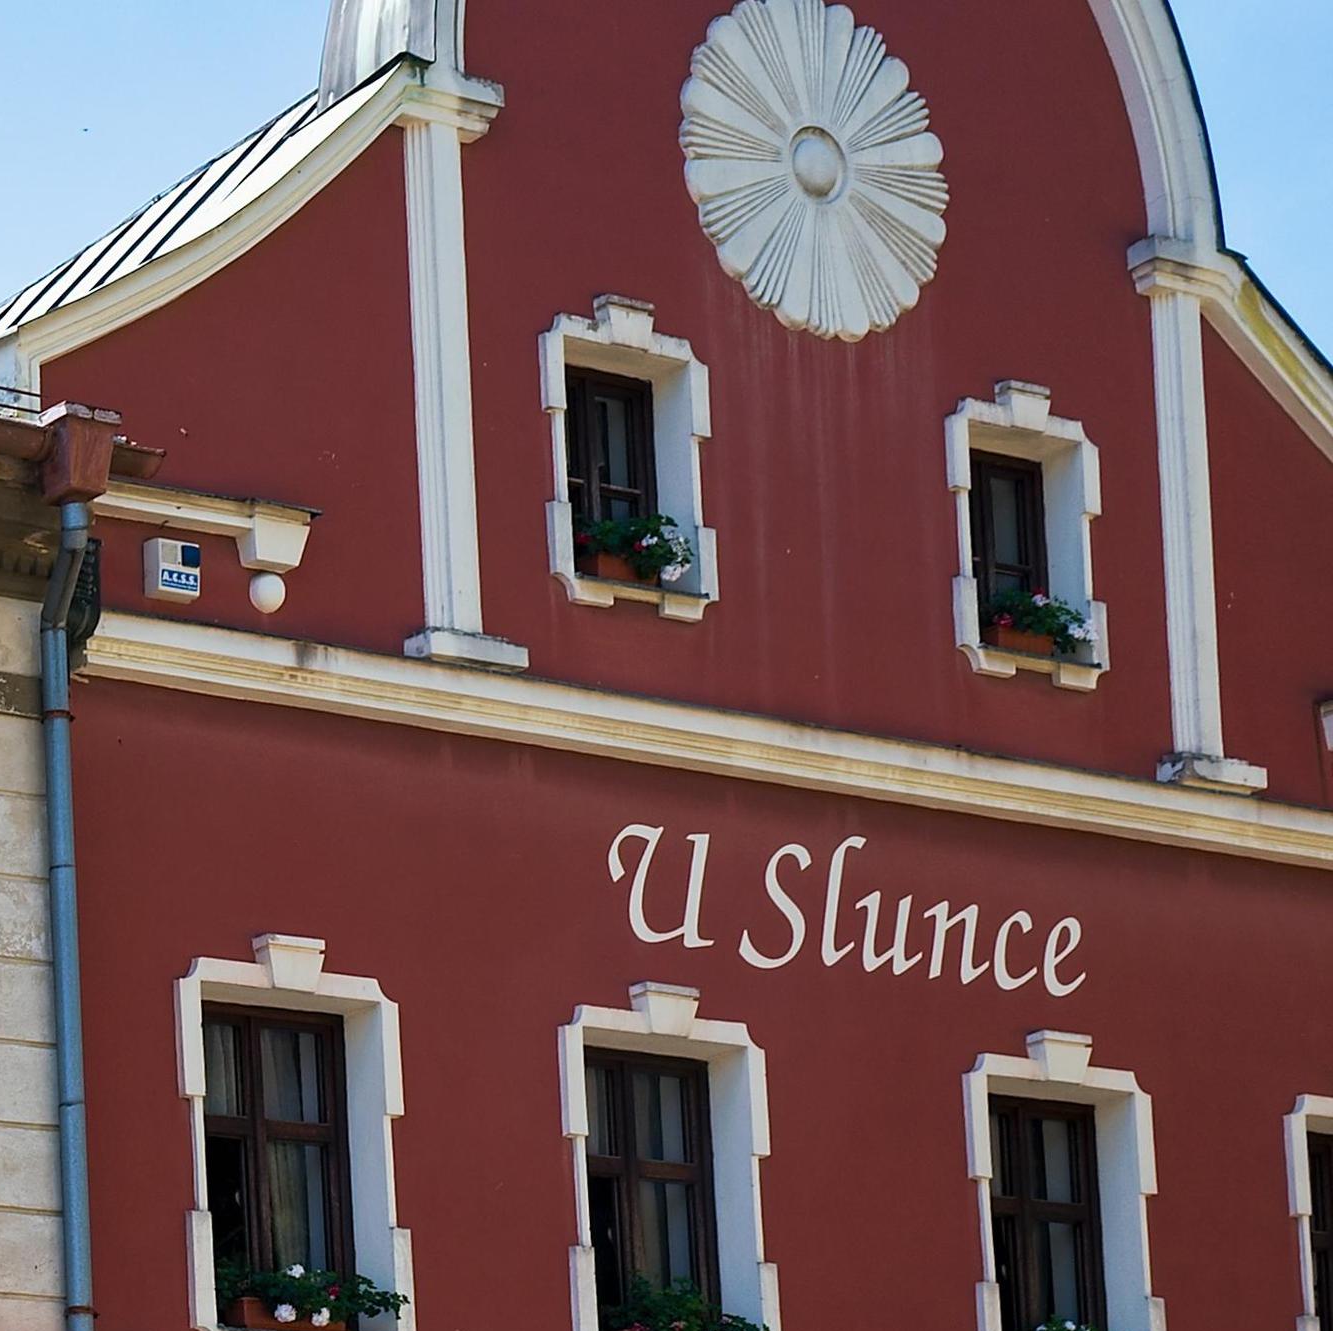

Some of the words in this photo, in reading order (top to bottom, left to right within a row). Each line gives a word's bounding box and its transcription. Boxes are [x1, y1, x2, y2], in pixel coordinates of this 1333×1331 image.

[162, 570, 198, 586] A.C.S.S.
[608, 823, 715, 949] U
[738, 835, 1087, 997] Slunce
